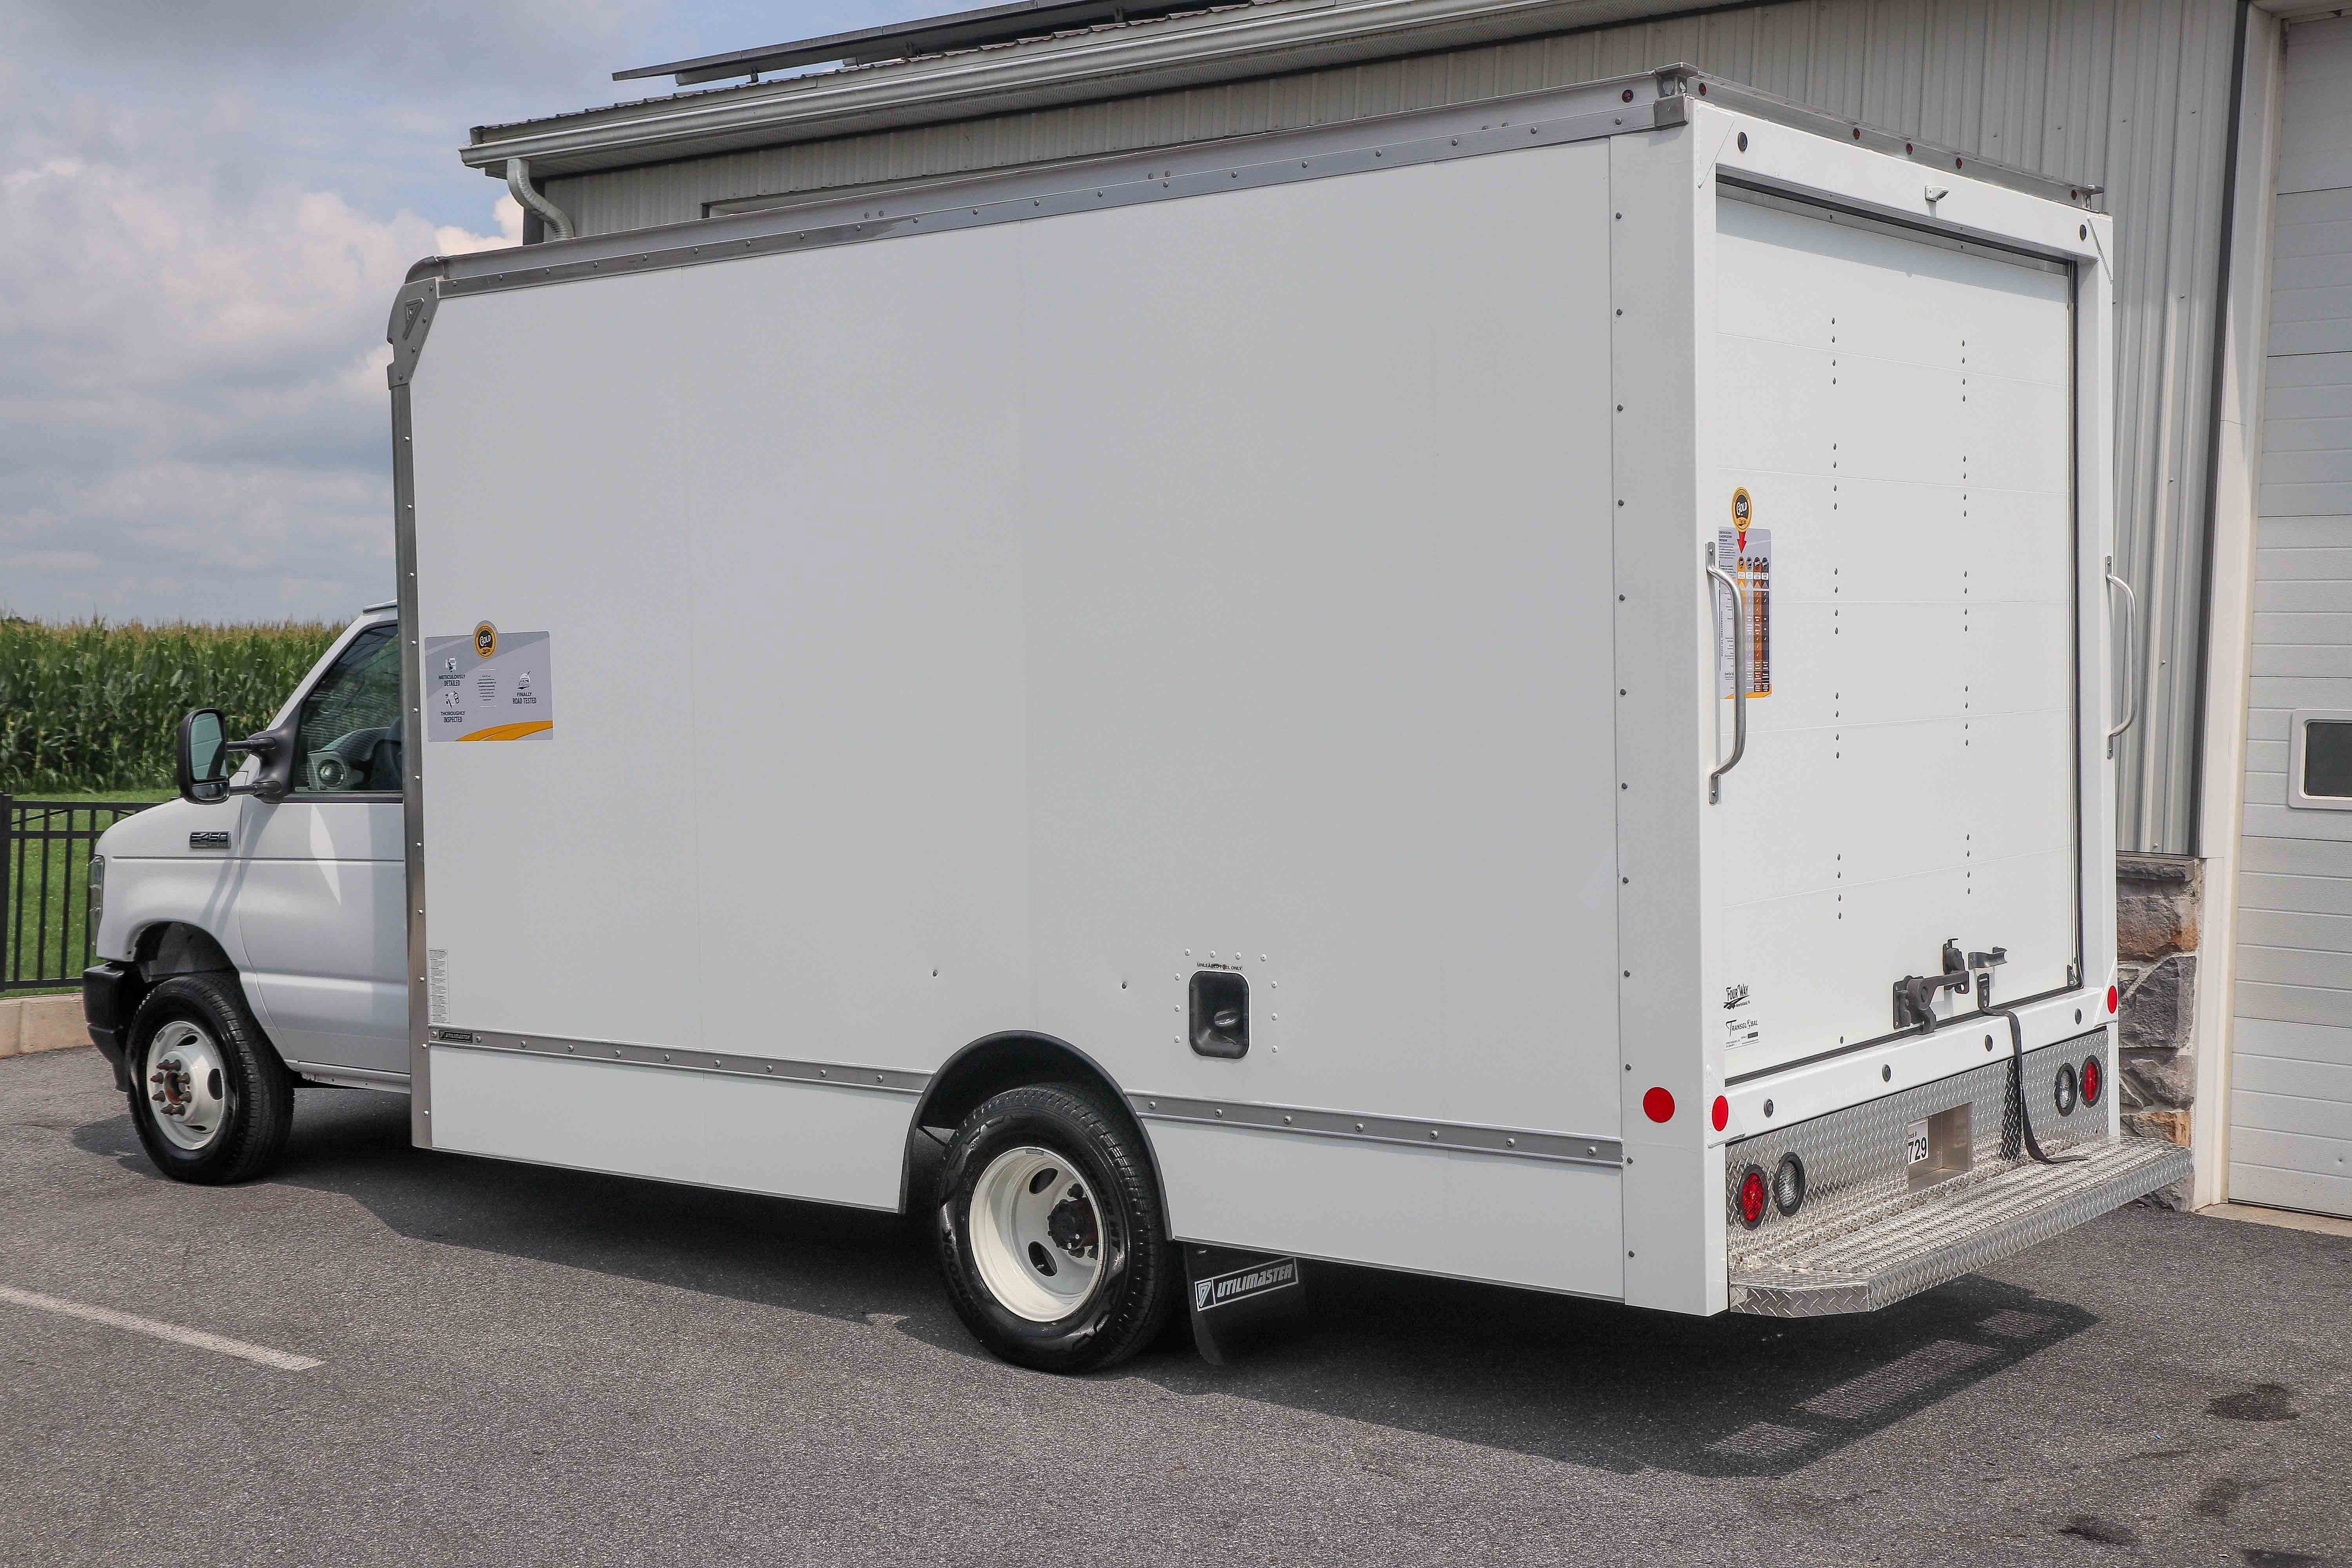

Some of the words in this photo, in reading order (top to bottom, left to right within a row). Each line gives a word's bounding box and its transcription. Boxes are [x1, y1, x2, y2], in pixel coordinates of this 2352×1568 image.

[1736, 501, 1747, 515] GOLD
[479, 635, 491, 646] GOLD
[1908, 1137, 1927, 1163] 729
